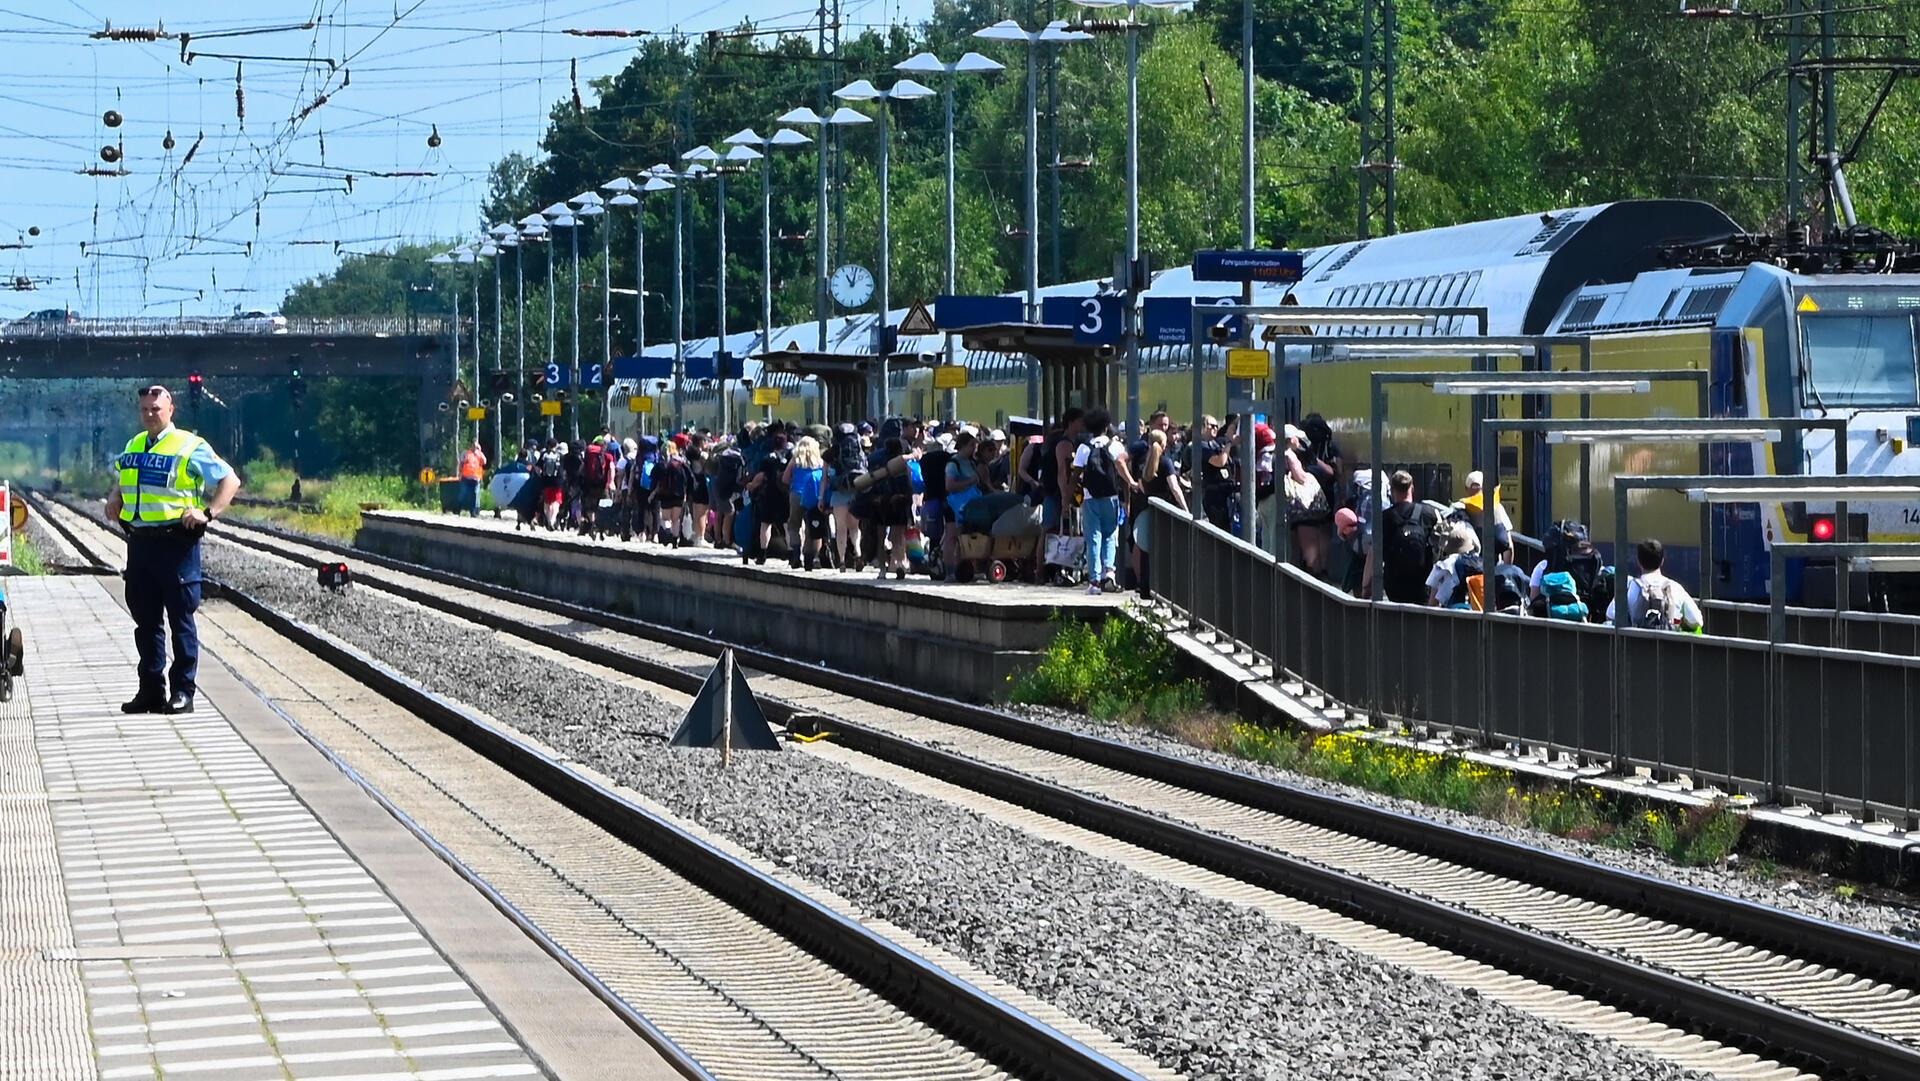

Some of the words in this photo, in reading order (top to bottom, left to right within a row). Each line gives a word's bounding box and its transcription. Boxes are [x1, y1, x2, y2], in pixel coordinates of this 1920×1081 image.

[1080, 298, 1102, 334] 3
[546, 364, 560, 384] 3
[591, 364, 602, 384] 2
[121, 454, 168, 469] POLIZEI
[1904, 508, 1920, 525] 14
